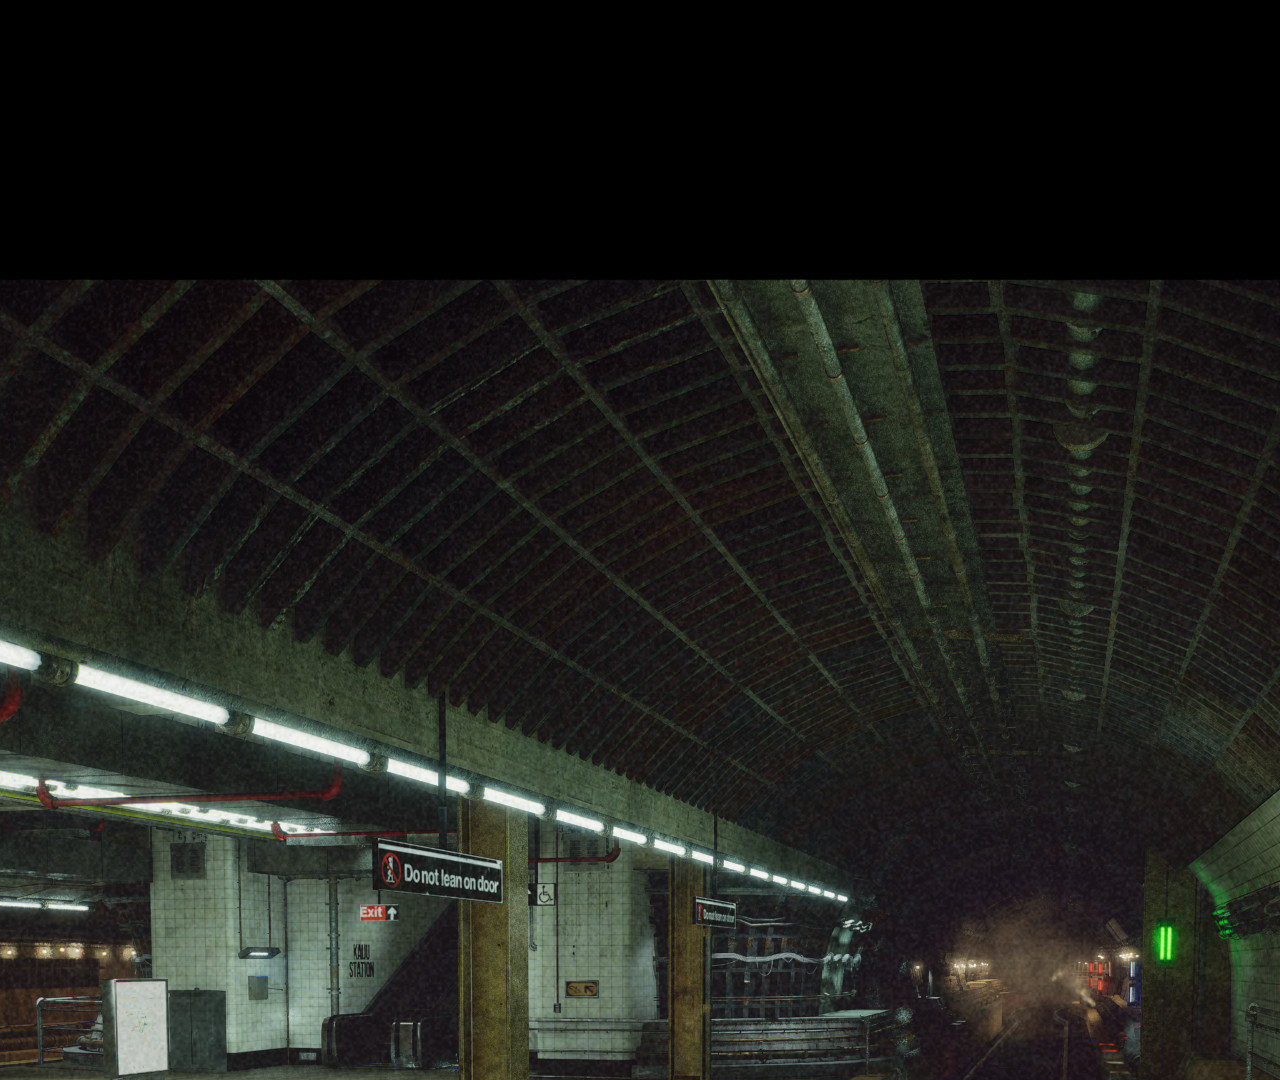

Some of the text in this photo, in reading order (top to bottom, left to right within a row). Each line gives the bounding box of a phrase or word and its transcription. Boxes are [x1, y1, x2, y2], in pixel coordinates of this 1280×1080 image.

[404, 863, 499, 893] Do not lean on door
[360, 906, 382, 917] Exit
[353, 944, 370, 960] KAIJU
[349, 961, 375, 977] STATION
